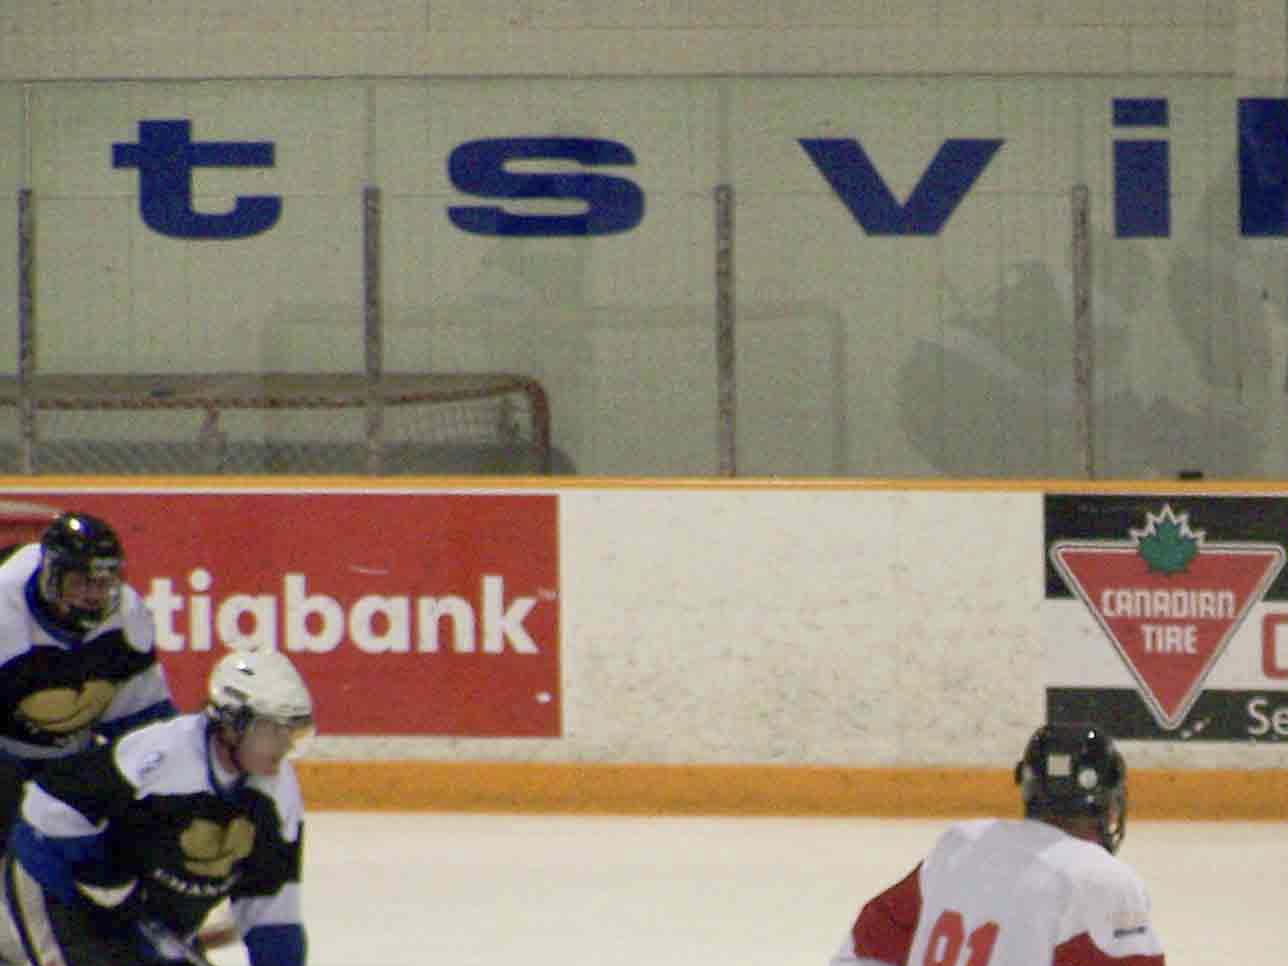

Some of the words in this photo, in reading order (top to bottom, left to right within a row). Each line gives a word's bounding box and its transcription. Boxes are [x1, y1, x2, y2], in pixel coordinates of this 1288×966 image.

[144, 568, 538, 655] tiabank
[1102, 588, 1236, 619] CANADIAN
[1141, 623, 1199, 654] TIRE
